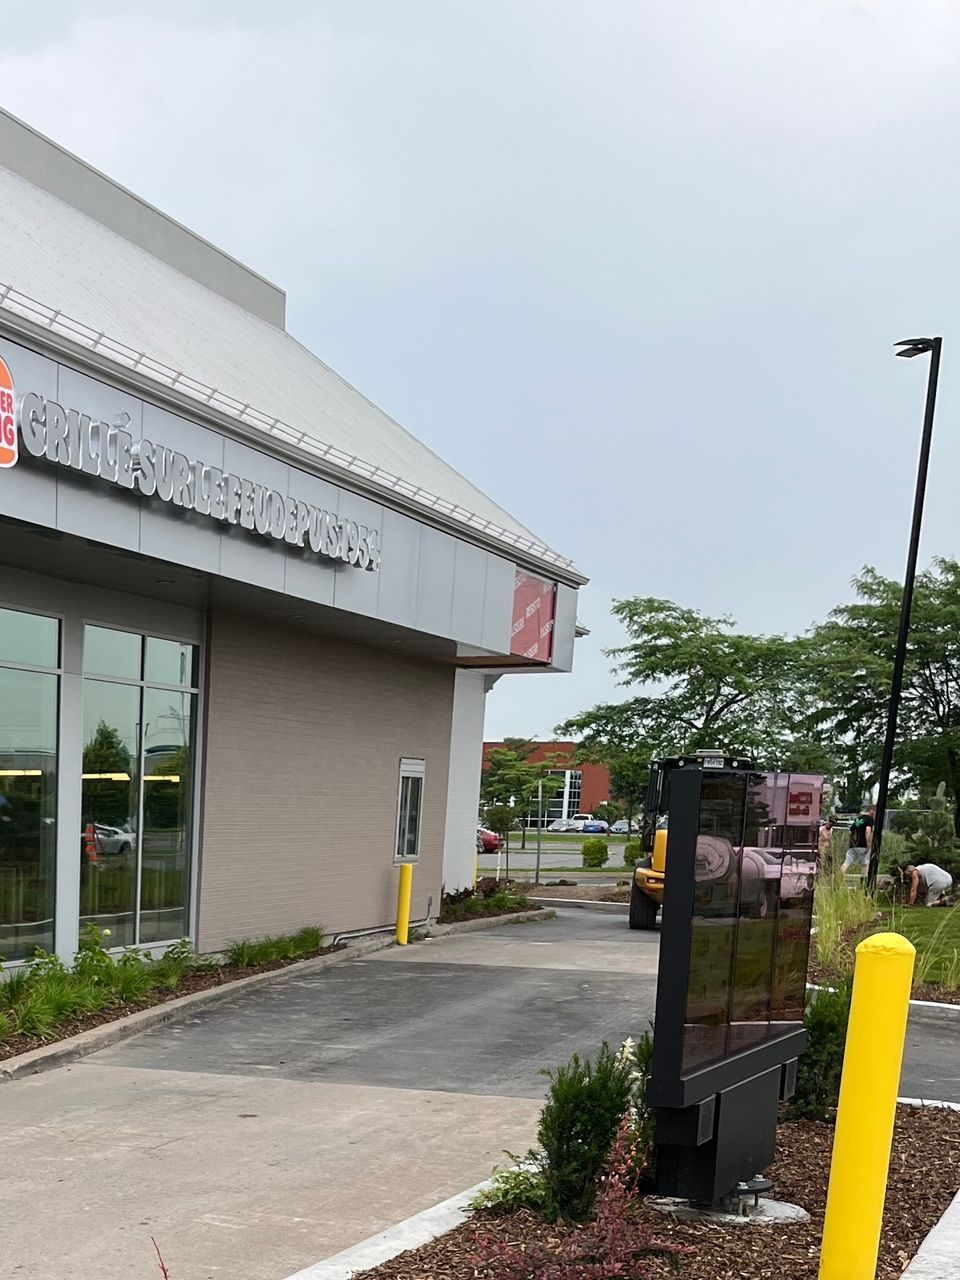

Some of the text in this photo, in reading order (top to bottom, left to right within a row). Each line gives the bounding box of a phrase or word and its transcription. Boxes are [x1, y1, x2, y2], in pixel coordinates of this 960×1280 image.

[20, 391, 381, 572] GRILLÉ SUR LE FEU DEPUIS 1954
